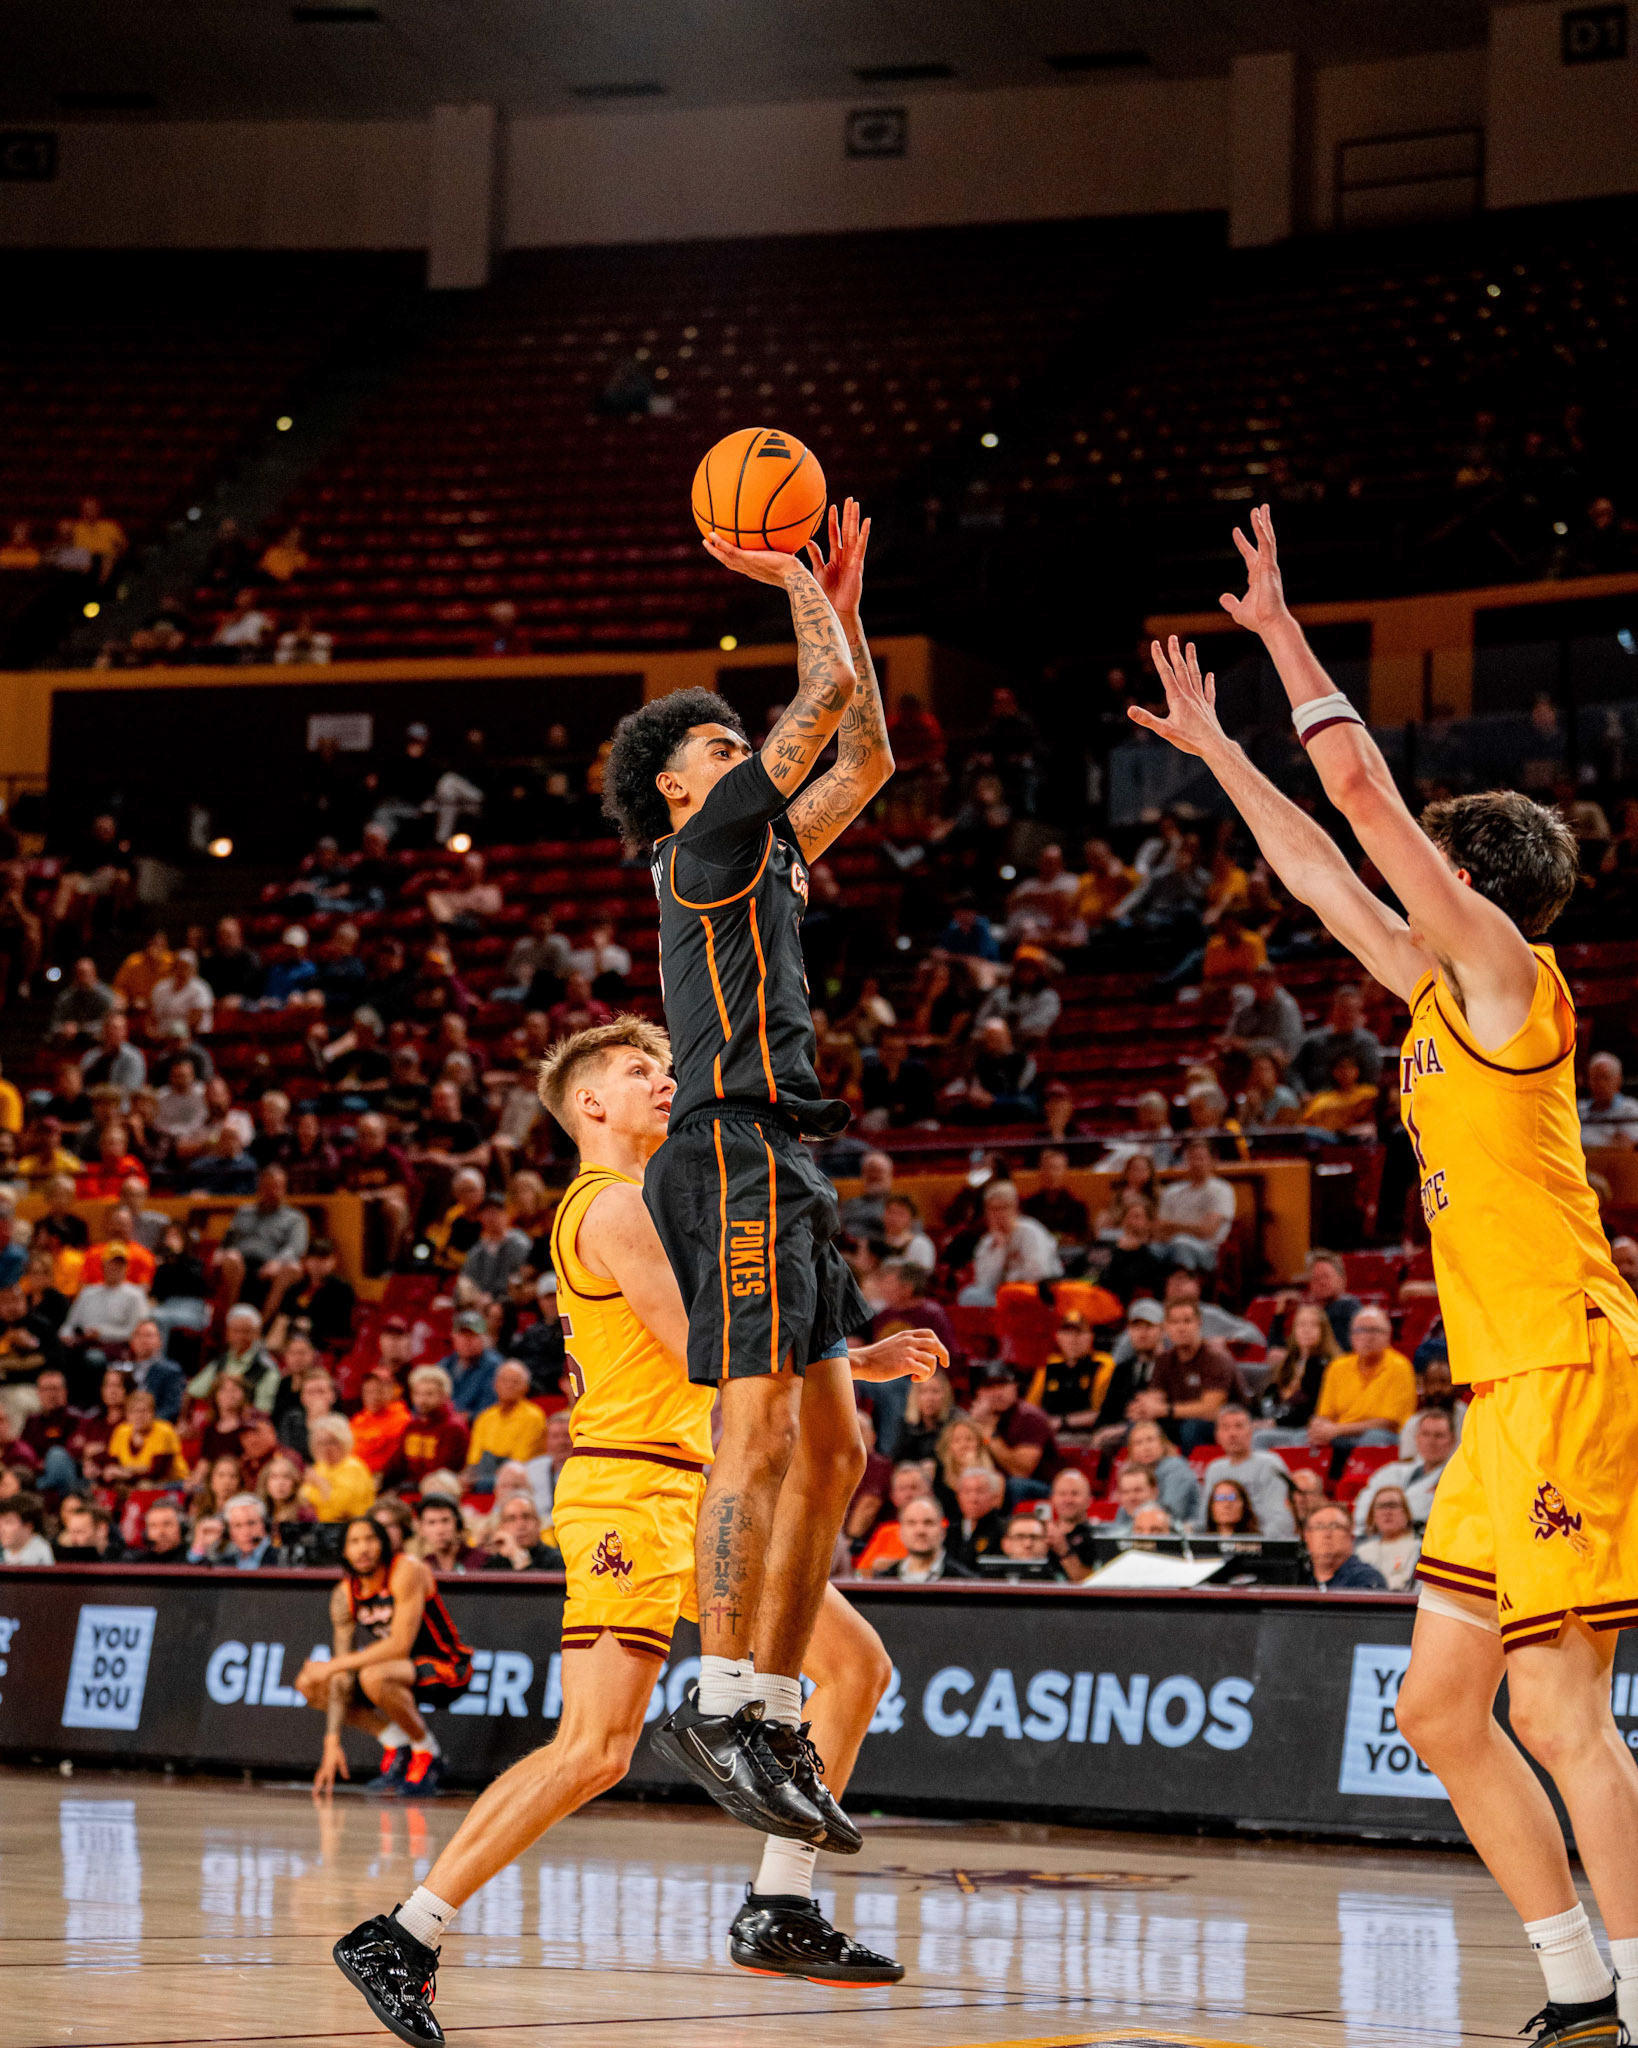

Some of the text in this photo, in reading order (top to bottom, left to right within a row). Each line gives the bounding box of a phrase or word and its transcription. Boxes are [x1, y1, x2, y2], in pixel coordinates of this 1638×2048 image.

[730, 1220, 766, 1298] POKES
[92, 1626, 140, 1649] YOU
[93, 1656, 126, 1679] DO
[82, 1686, 131, 1710] YOU
[922, 1665, 1255, 1751] CASINOS
